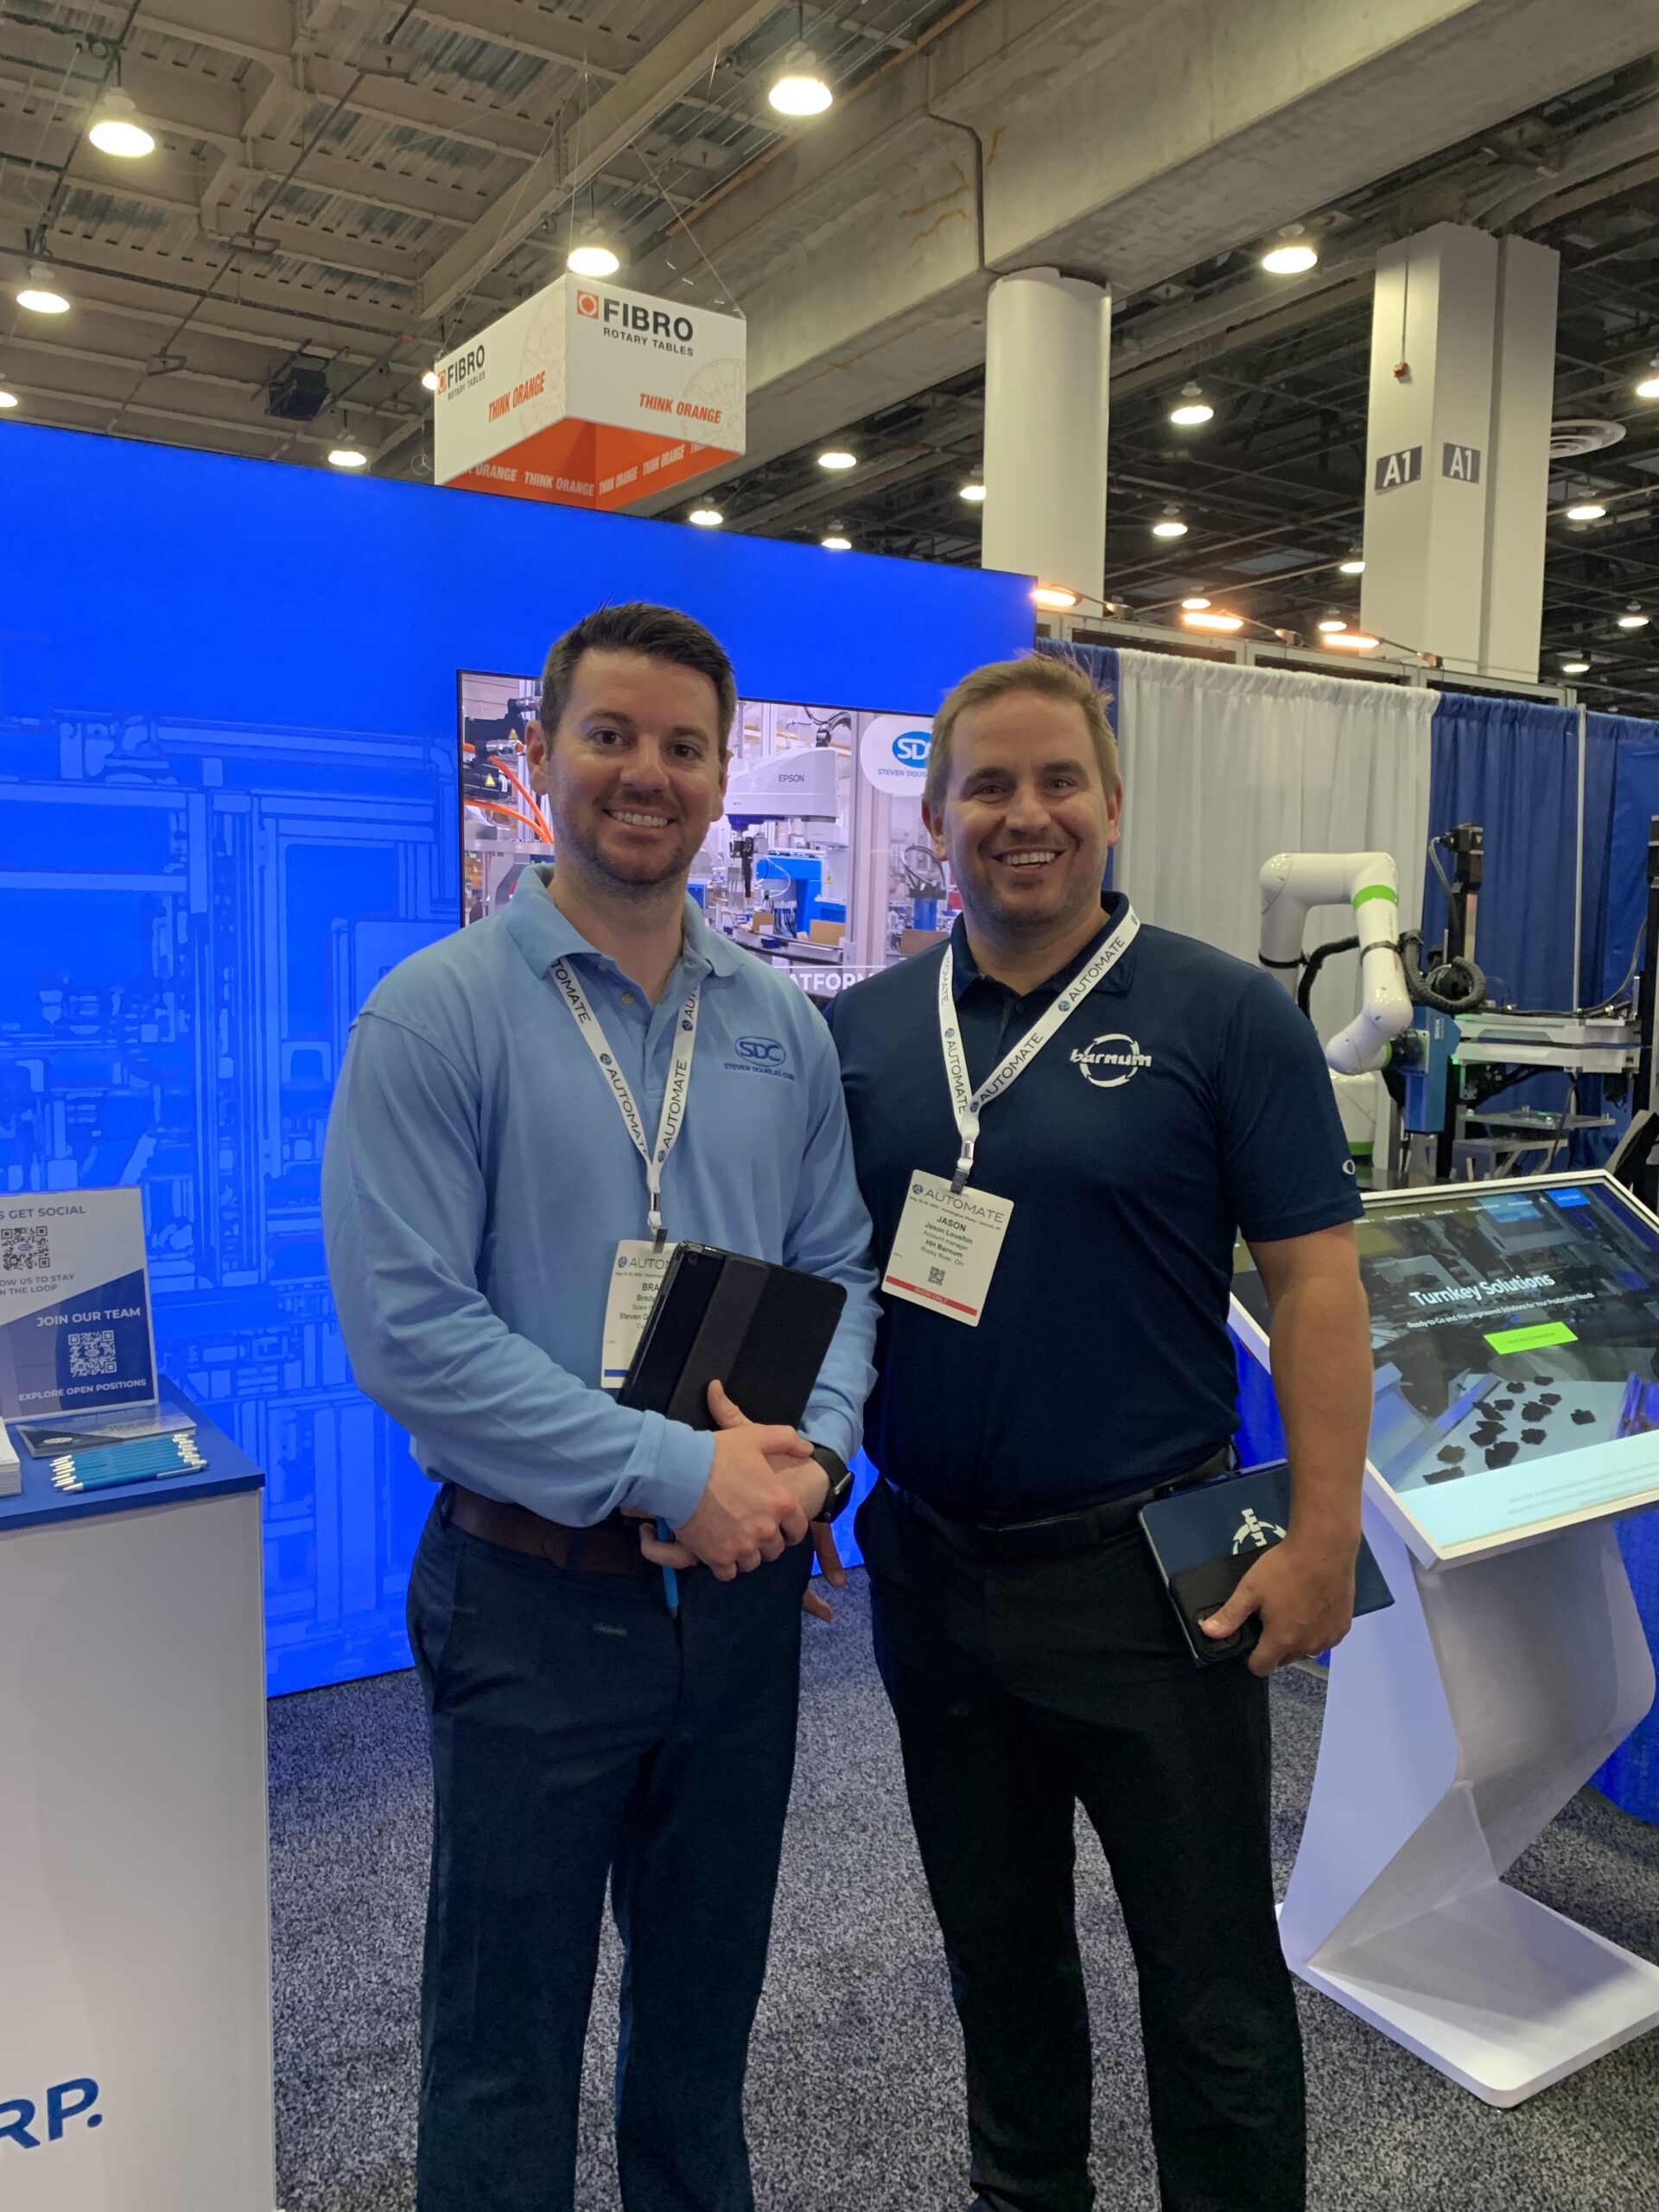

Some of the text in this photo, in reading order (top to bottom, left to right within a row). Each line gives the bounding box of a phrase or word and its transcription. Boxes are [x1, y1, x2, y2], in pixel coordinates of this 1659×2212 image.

[604, 298, 693, 342] FIBRO
[603, 327, 694, 357] ROTARY TABLES
[448, 345, 486, 388] FIBRO
[448, 372, 486, 401] ROTARY TABLES
[488, 371, 546, 423] THINK ORANGE
[639, 393, 722, 424] THINK ORANGE
[476, 463, 518, 482] ORANGE
[643, 456, 659, 476] THINK
[660, 444, 685, 467] ORANGE
[1382, 451, 1411, 487] A1
[1449, 447, 1471, 480] A1
[524, 471, 595, 497] THINK ORANGE
[598, 466, 638, 495] THINK ORANGE
[779, 774, 804, 783] EPSON
[877, 768, 928, 778] STEVEN DOUG
[1069, 936, 1125, 1002] AUTOMATE
[739, 1041, 781, 1062] SDC
[1070, 1048, 1152, 1067] barnum
[947, 1040, 968, 1114] AUTOMATE
[979, 1032, 1044, 1103] AUTOMATE
[607, 1068, 648, 1152] AUTOMAT
[664, 1059, 687, 1148] AUTOMATE
[9, 1209, 35, 1219] GET
[38, 1205, 86, 1217] SOCIAL
[925, 1189, 1005, 1224] AUTOMATE
[925, 1222, 944, 1234] Jason
[936, 1216, 966, 1232] JASON
[30, 1284, 58, 1294] LOOP
[35, 1275, 48, 1284] TO
[50, 1274, 75, 1282] STAY
[642, 1282, 659, 1291] BRA
[1408, 1274, 1556, 1306] Turnkey Solutions
[36, 1306, 141, 1327] JOIN OUR TEAM
[1500, 1303, 1528, 1313] Solutions
[19, 1378, 147, 1402] EXPLORE OPEN POSITIONS
